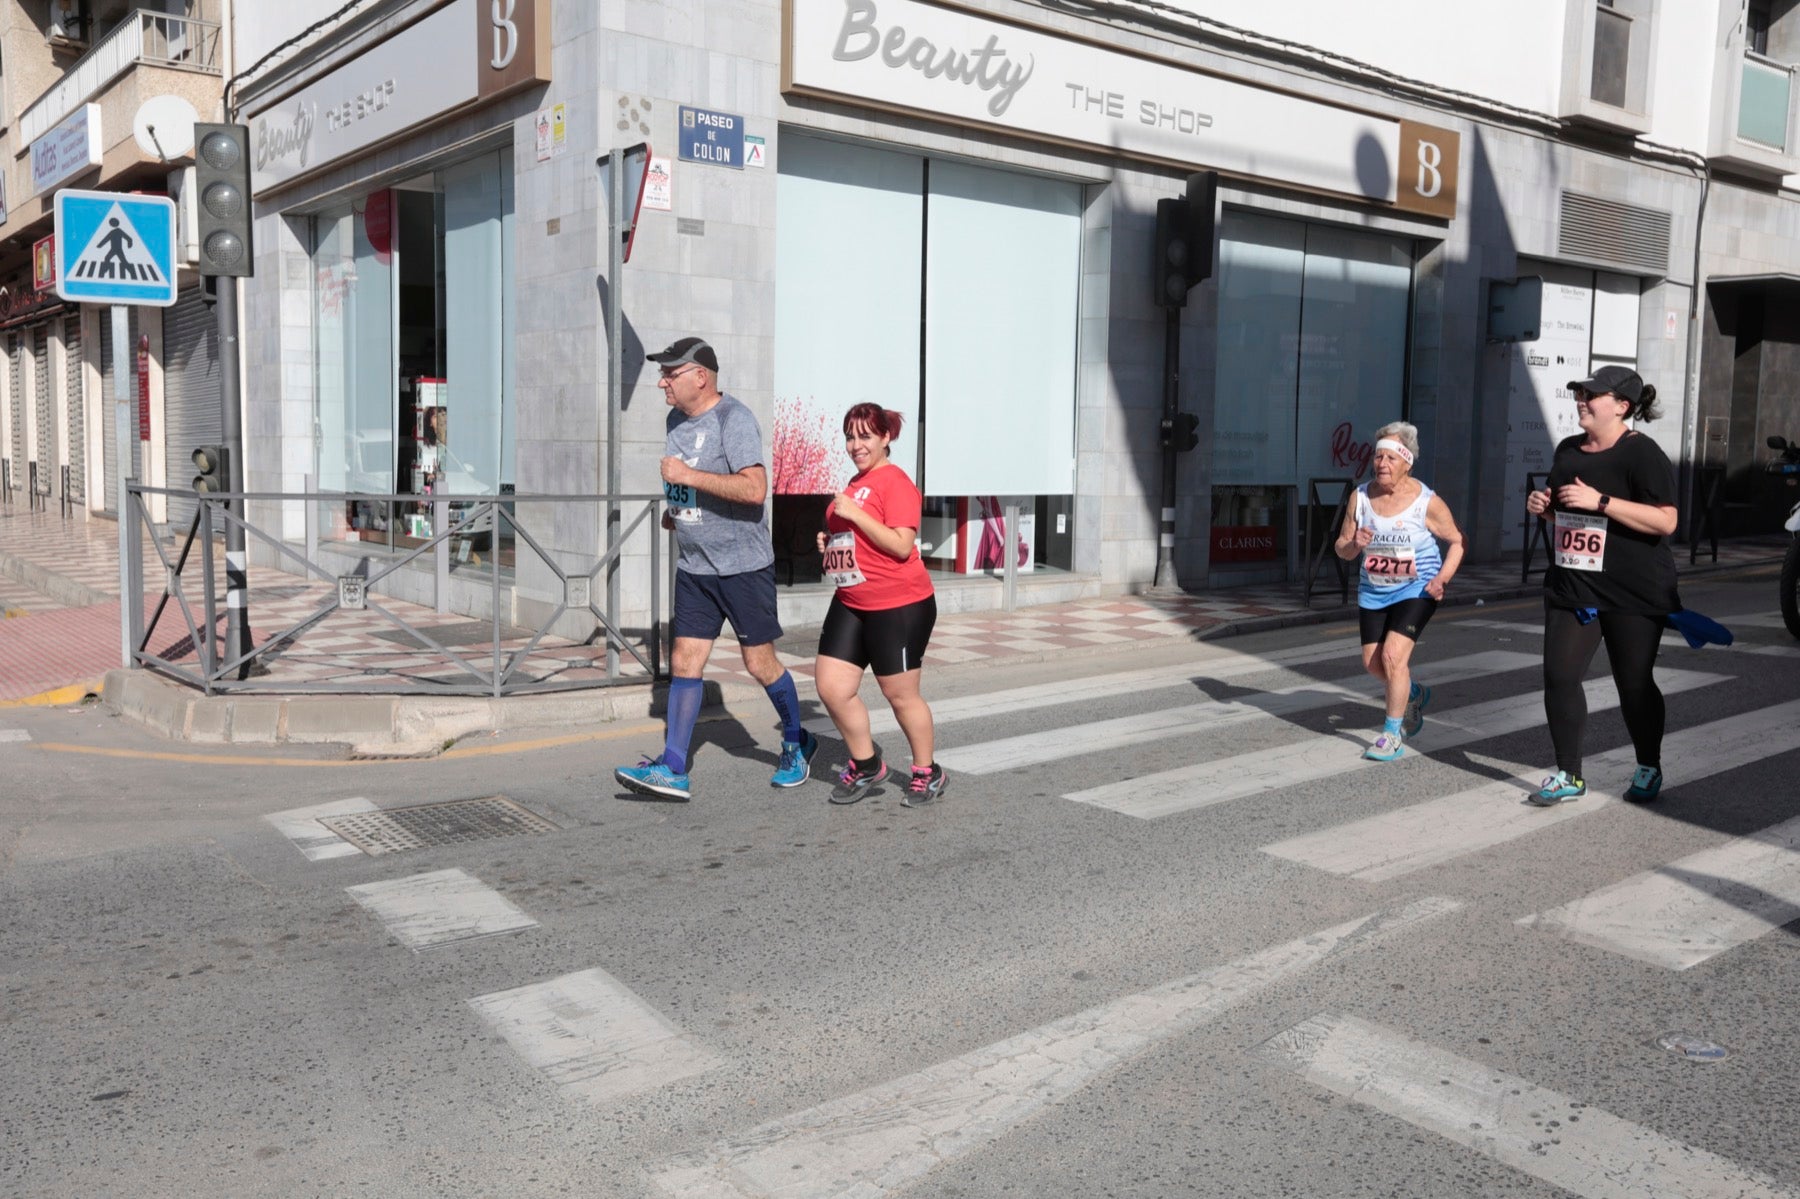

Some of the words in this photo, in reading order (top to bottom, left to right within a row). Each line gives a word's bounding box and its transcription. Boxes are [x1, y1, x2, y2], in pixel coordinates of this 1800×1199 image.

[491, 0, 518, 70] B
[832, 0, 1035, 118] Beauty
[1065, 82, 1124, 119] THE
[1139, 99, 1213, 136] SHOP
[257, 101, 317, 172] Beauty
[326, 101, 351, 134] THE
[357, 77, 396, 120] SHOP
[698, 112, 733, 130] PASEO
[707, 130, 716, 141] DE
[693, 142, 731, 163] COLON
[1415, 139, 1442, 198] B
[666, 482, 689, 504] 235
[1219, 536, 1273, 549] CLARINS
[1562, 530, 1601, 554] 056
[825, 549, 855, 570] 2073
[1368, 557, 1412, 575] 2277
